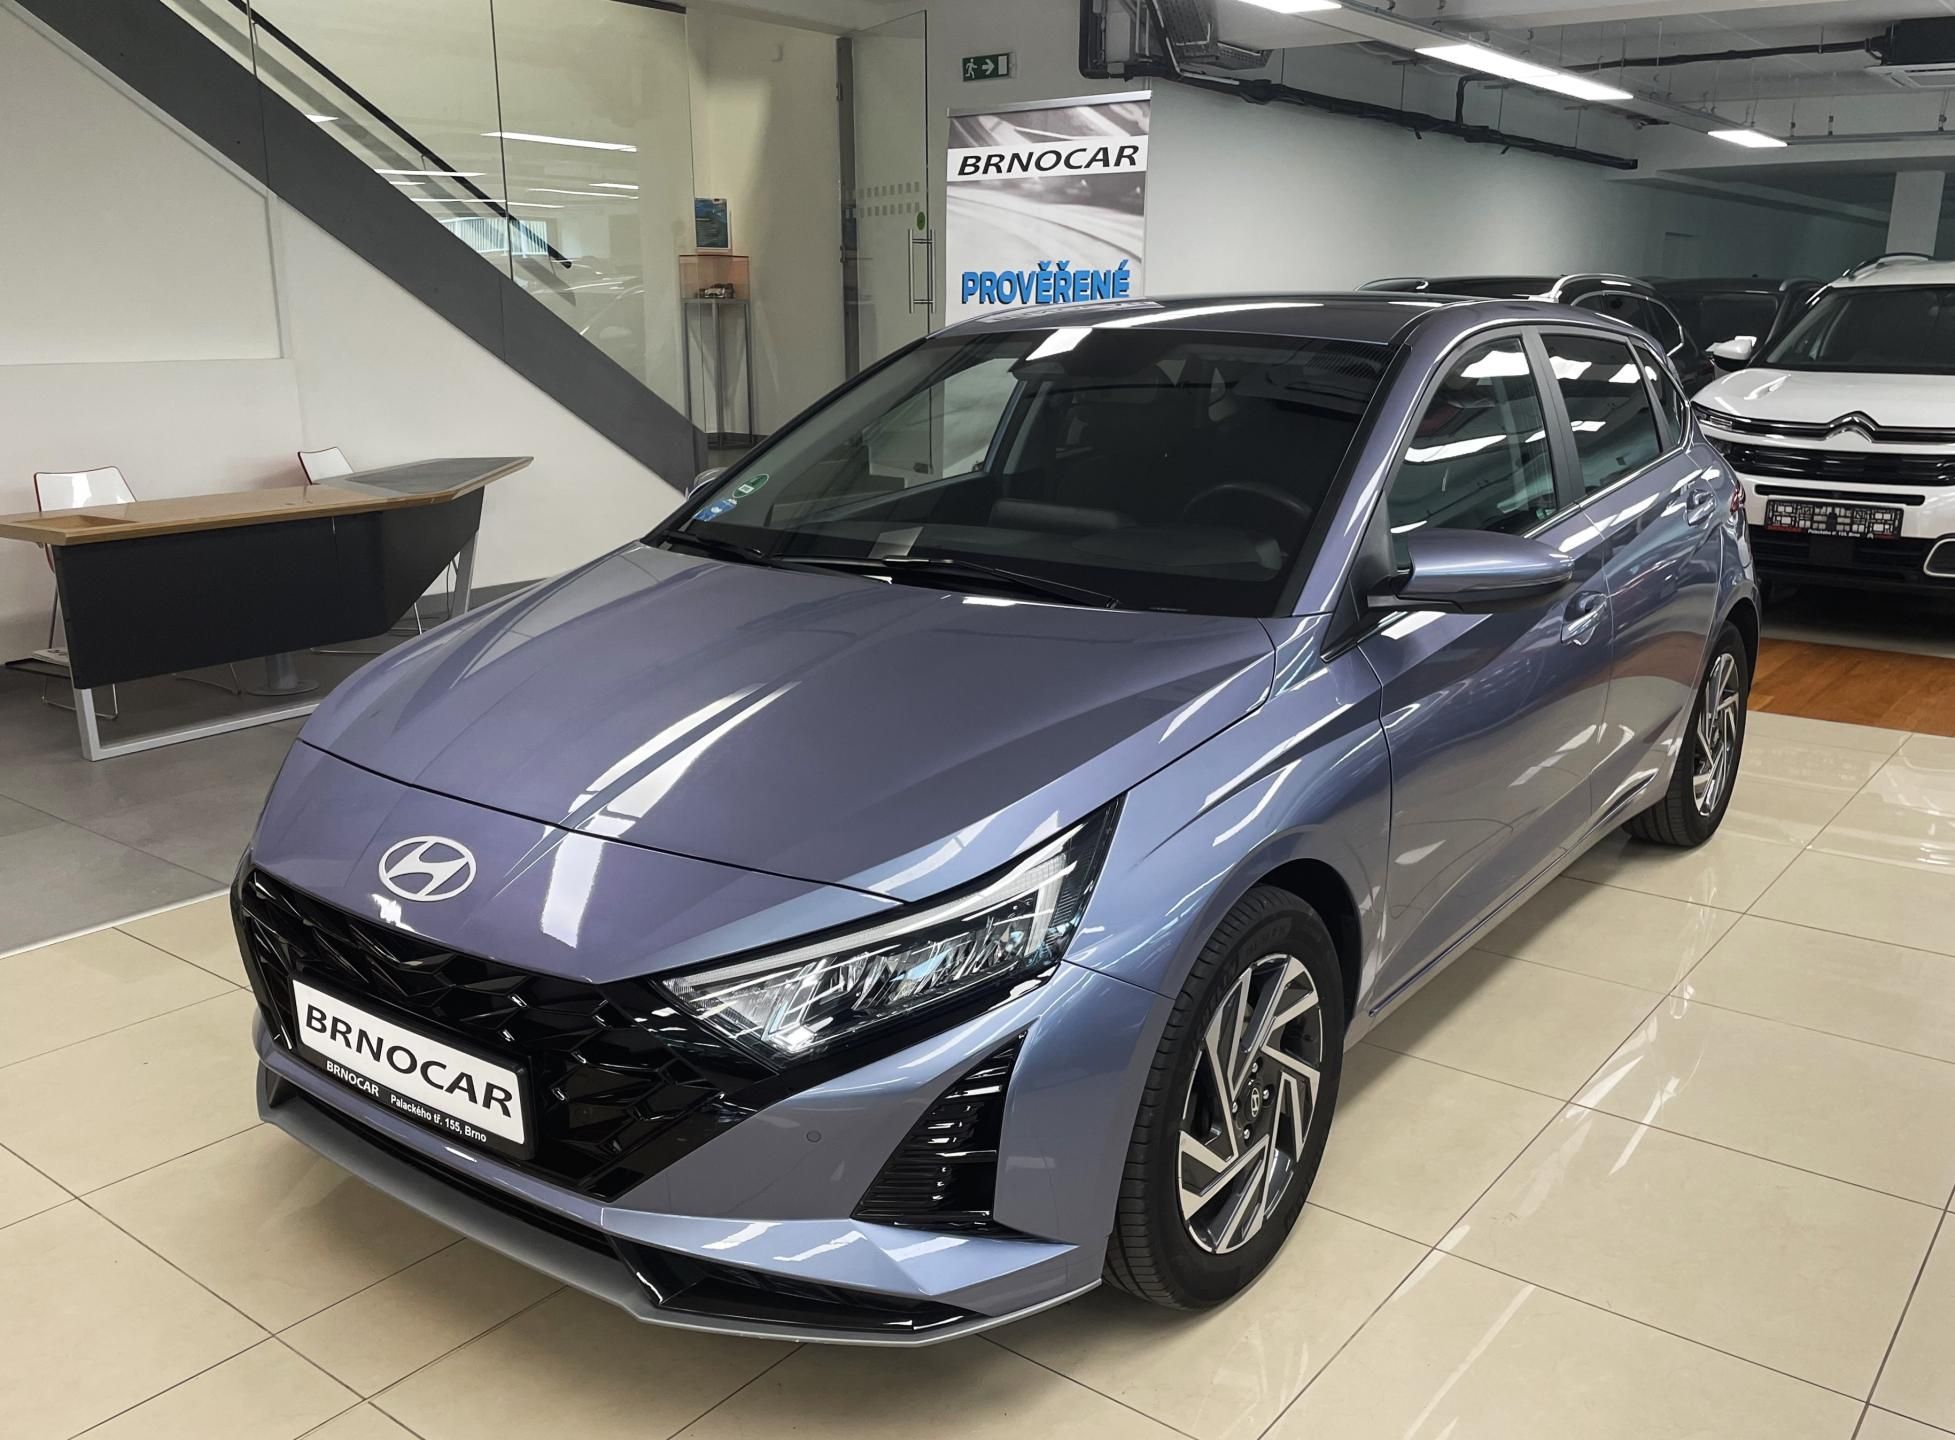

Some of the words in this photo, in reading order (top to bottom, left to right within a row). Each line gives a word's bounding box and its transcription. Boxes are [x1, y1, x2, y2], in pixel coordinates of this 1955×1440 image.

[957, 145, 1139, 176] BRNOCAR
[961, 259, 1130, 304] PROVĚŘENÉ
[306, 1004, 512, 1118] BRNOCAR
[327, 1060, 379, 1097] BRNOCAR
[391, 1094, 431, 1121] Palackého
[445, 1118, 463, 1135] 155,
[465, 1126, 487, 1142] Brno
